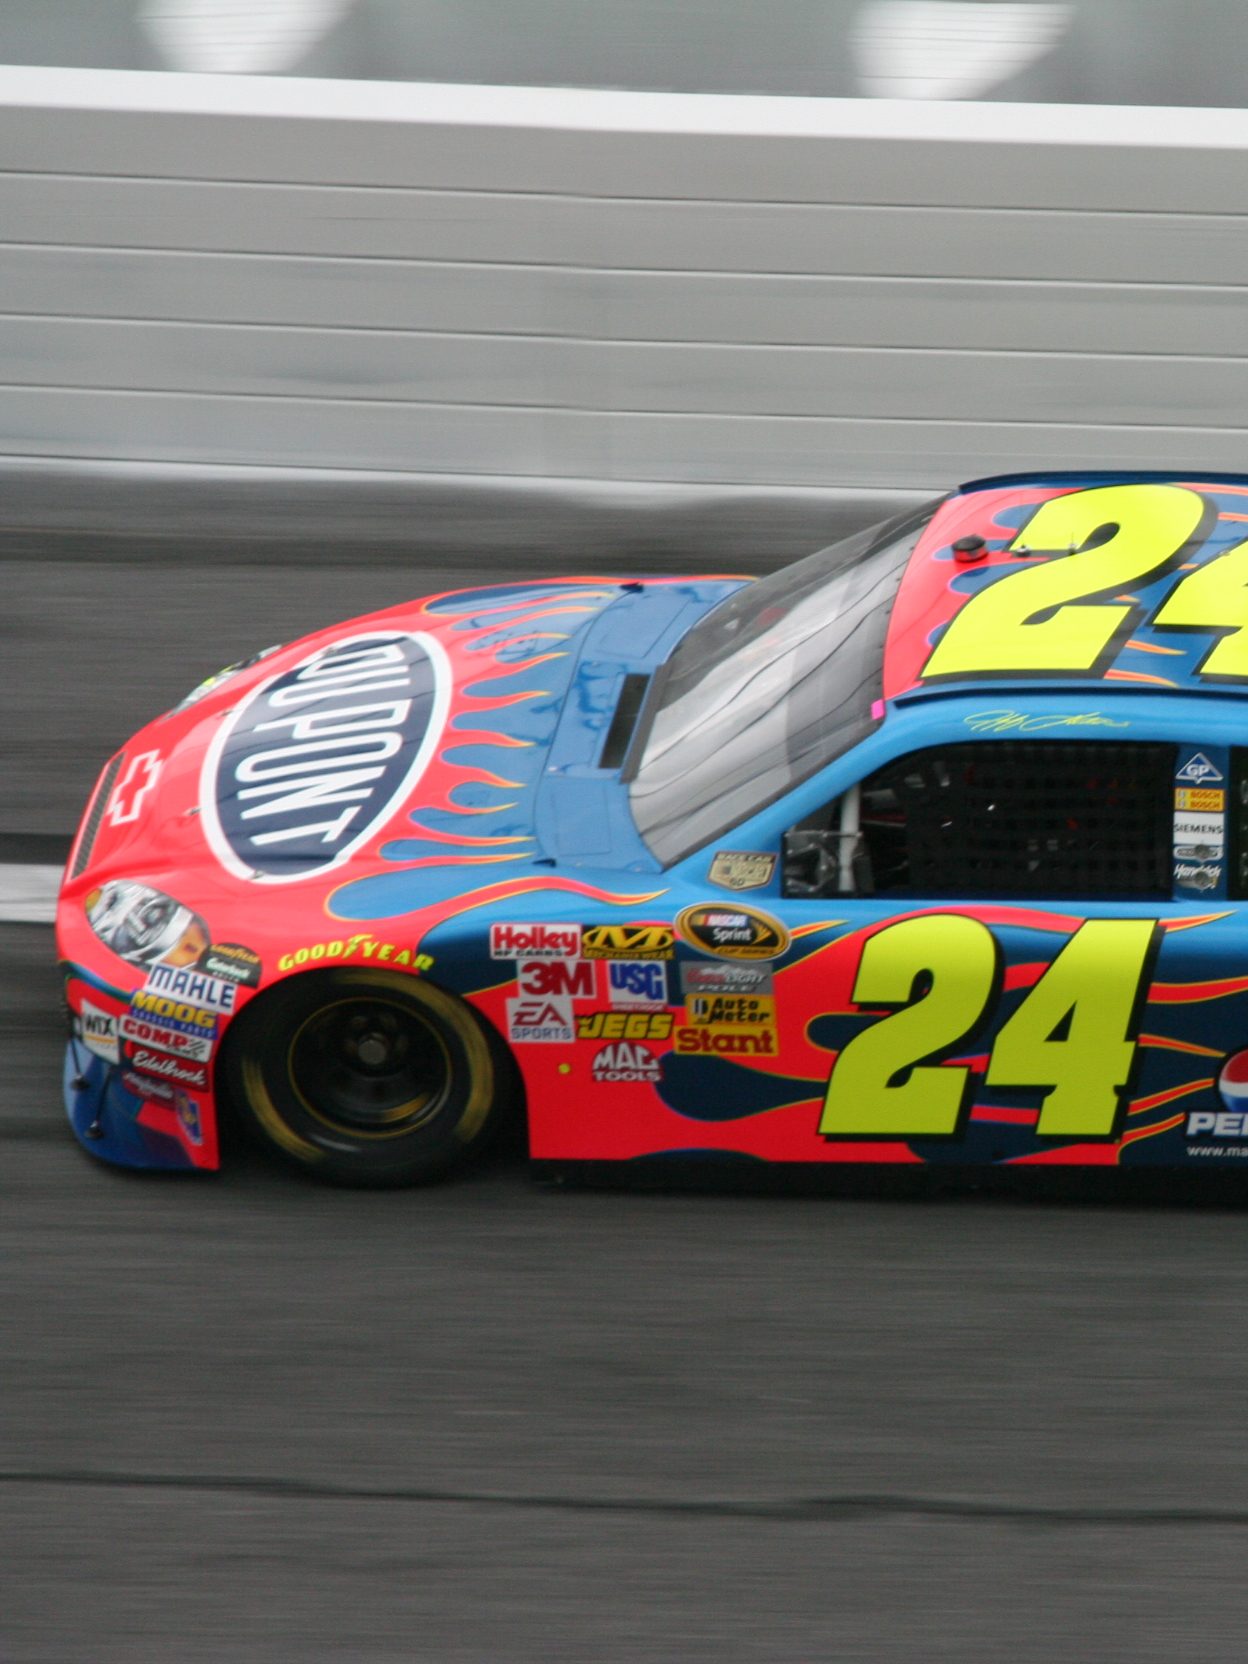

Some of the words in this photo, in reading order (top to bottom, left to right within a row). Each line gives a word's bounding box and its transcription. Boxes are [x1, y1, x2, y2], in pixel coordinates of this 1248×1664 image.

[1186, 764, 1210, 777] GP
[1173, 824, 1224, 834] SIEMENS
[707, 914, 748, 927] NASCAR
[494, 926, 578, 956] Holley
[712, 928, 752, 943] Sprint
[278, 934, 435, 972] GOODYEAR
[149, 965, 235, 1008] MAHLE
[521, 961, 595, 996] 3M
[609, 963, 664, 1000] USG
[132, 990, 217, 1029] MOOG
[512, 1001, 568, 1027] EA
[714, 997, 760, 1011] Auto
[585, 1013, 674, 1040] JEGS
[711, 1011, 771, 1024] Meter
[818, 914, 1159, 1136] 24
[123, 1018, 190, 1048] COMP
[511, 1027, 571, 1040] SPORTS
[677, 1029, 774, 1054] Stant
[593, 1041, 660, 1070] MAC
[592, 1071, 662, 1082] TOOLS
